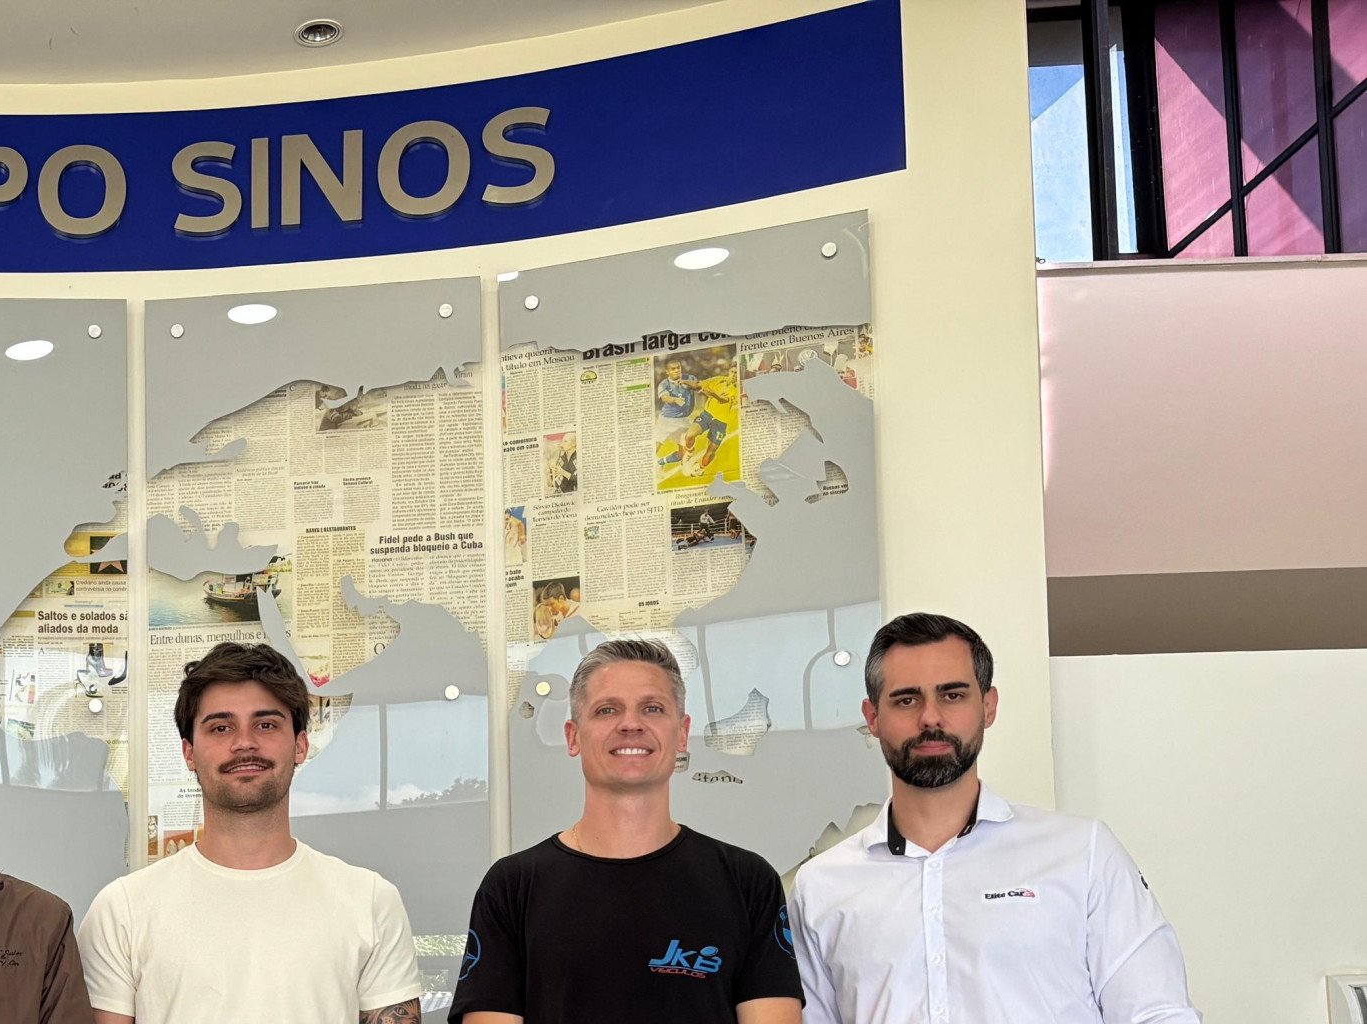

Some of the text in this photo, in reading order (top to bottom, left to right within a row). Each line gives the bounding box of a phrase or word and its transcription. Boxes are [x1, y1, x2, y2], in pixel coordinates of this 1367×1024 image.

[173, 106, 552, 234] SINOS
[740, 342, 768, 352] frente
[770, 339, 786, 347] em
[789, 332, 825, 344] Buenos
[827, 327, 855, 338] Aires
[543, 355, 575, 365] Moscou
[379, 535, 400, 544] Fidel
[403, 534, 423, 546] pede
[434, 532, 456, 541] Bush
[458, 532, 474, 543] que
[370, 544, 411, 555] suspenda
[413, 542, 450, 553] bloqueio
[461, 541, 483, 550] Cuba
[38, 611, 68, 621] Saltos
[71, 613, 77, 621] e
[80, 611, 116, 621] solados
[38, 623, 119, 633] aliados da moda
[150, 633, 174, 645] Entre
[175, 631, 205, 644] dunas,
[207, 629, 255, 643] mergulhos
